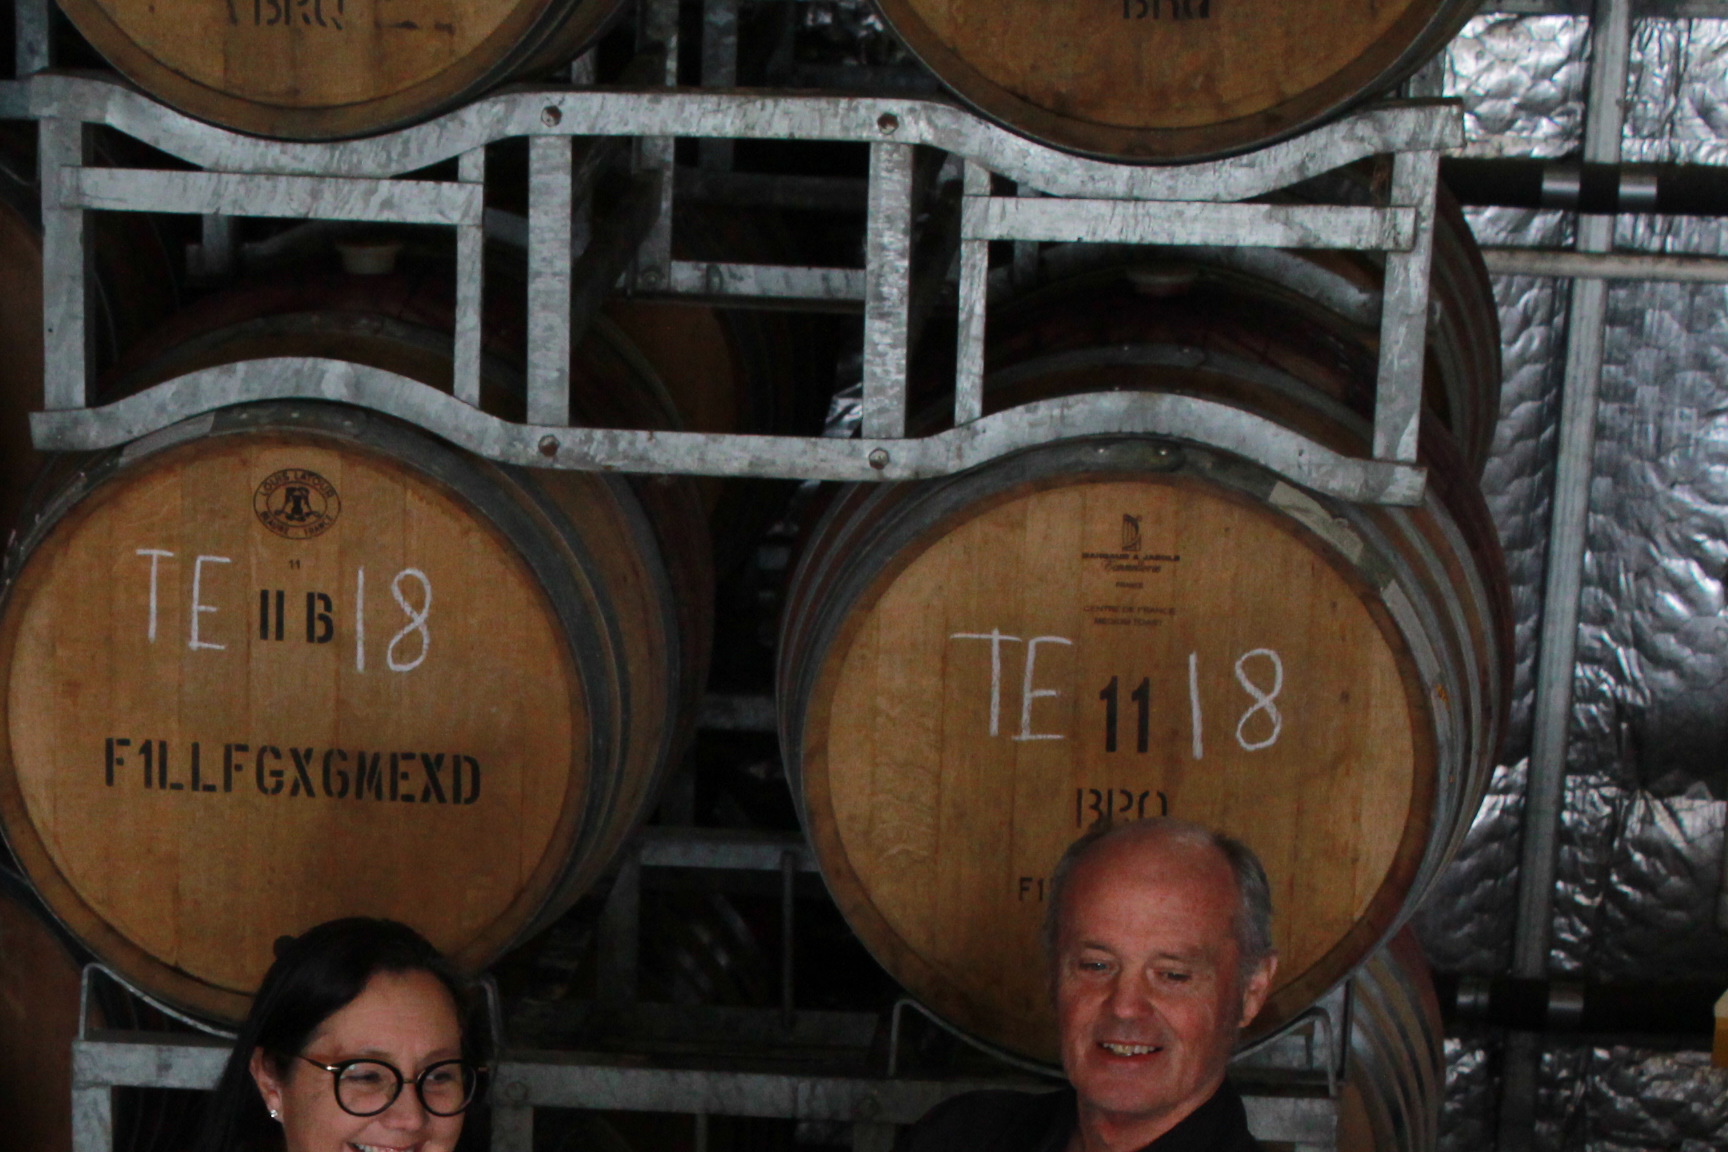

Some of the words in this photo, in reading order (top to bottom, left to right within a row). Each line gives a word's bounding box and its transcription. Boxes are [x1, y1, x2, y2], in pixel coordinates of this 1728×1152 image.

[259, 471, 290, 498] LOUIS
[294, 471, 336, 498] LATOUR
[136, 548, 233, 651] TE
[950, 628, 1073, 742] TE
[1188, 647, 1284, 760] 18
[1099, 675, 1150, 753] 11
